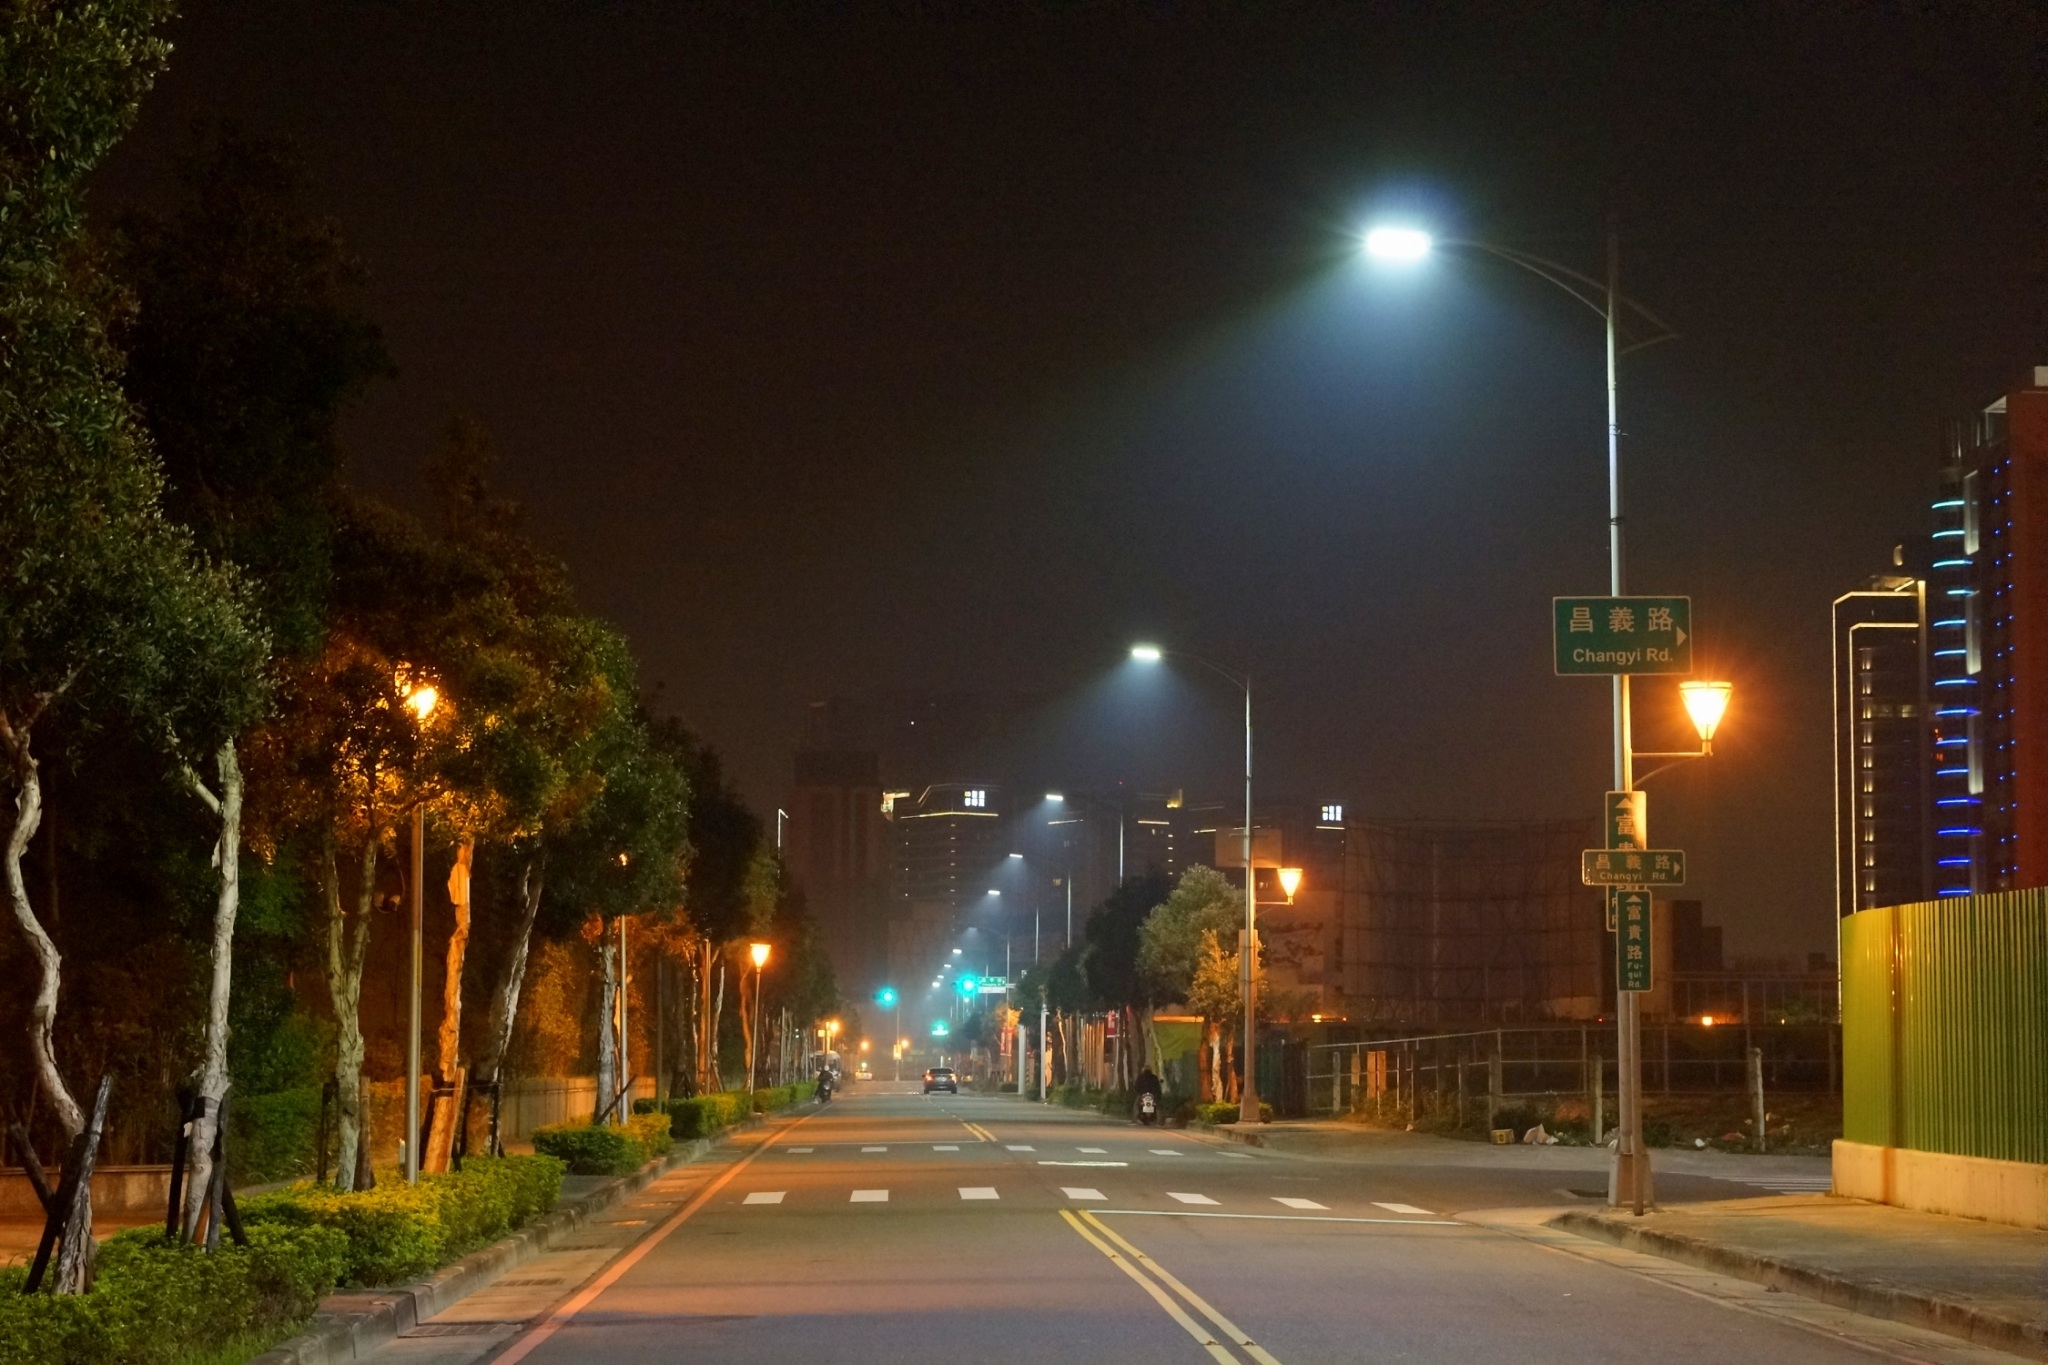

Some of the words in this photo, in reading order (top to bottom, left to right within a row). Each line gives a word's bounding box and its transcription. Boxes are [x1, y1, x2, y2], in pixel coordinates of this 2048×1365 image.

[1569, 606, 1674, 633] 昌義路
[1573, 648, 1641, 665] Changyi
[1646, 647, 1674, 662] Rd.
[1595, 853, 1671, 870] 昌義路
[1599, 871, 1643, 882] Changyi
[1626, 904, 1643, 960] 富貴路
